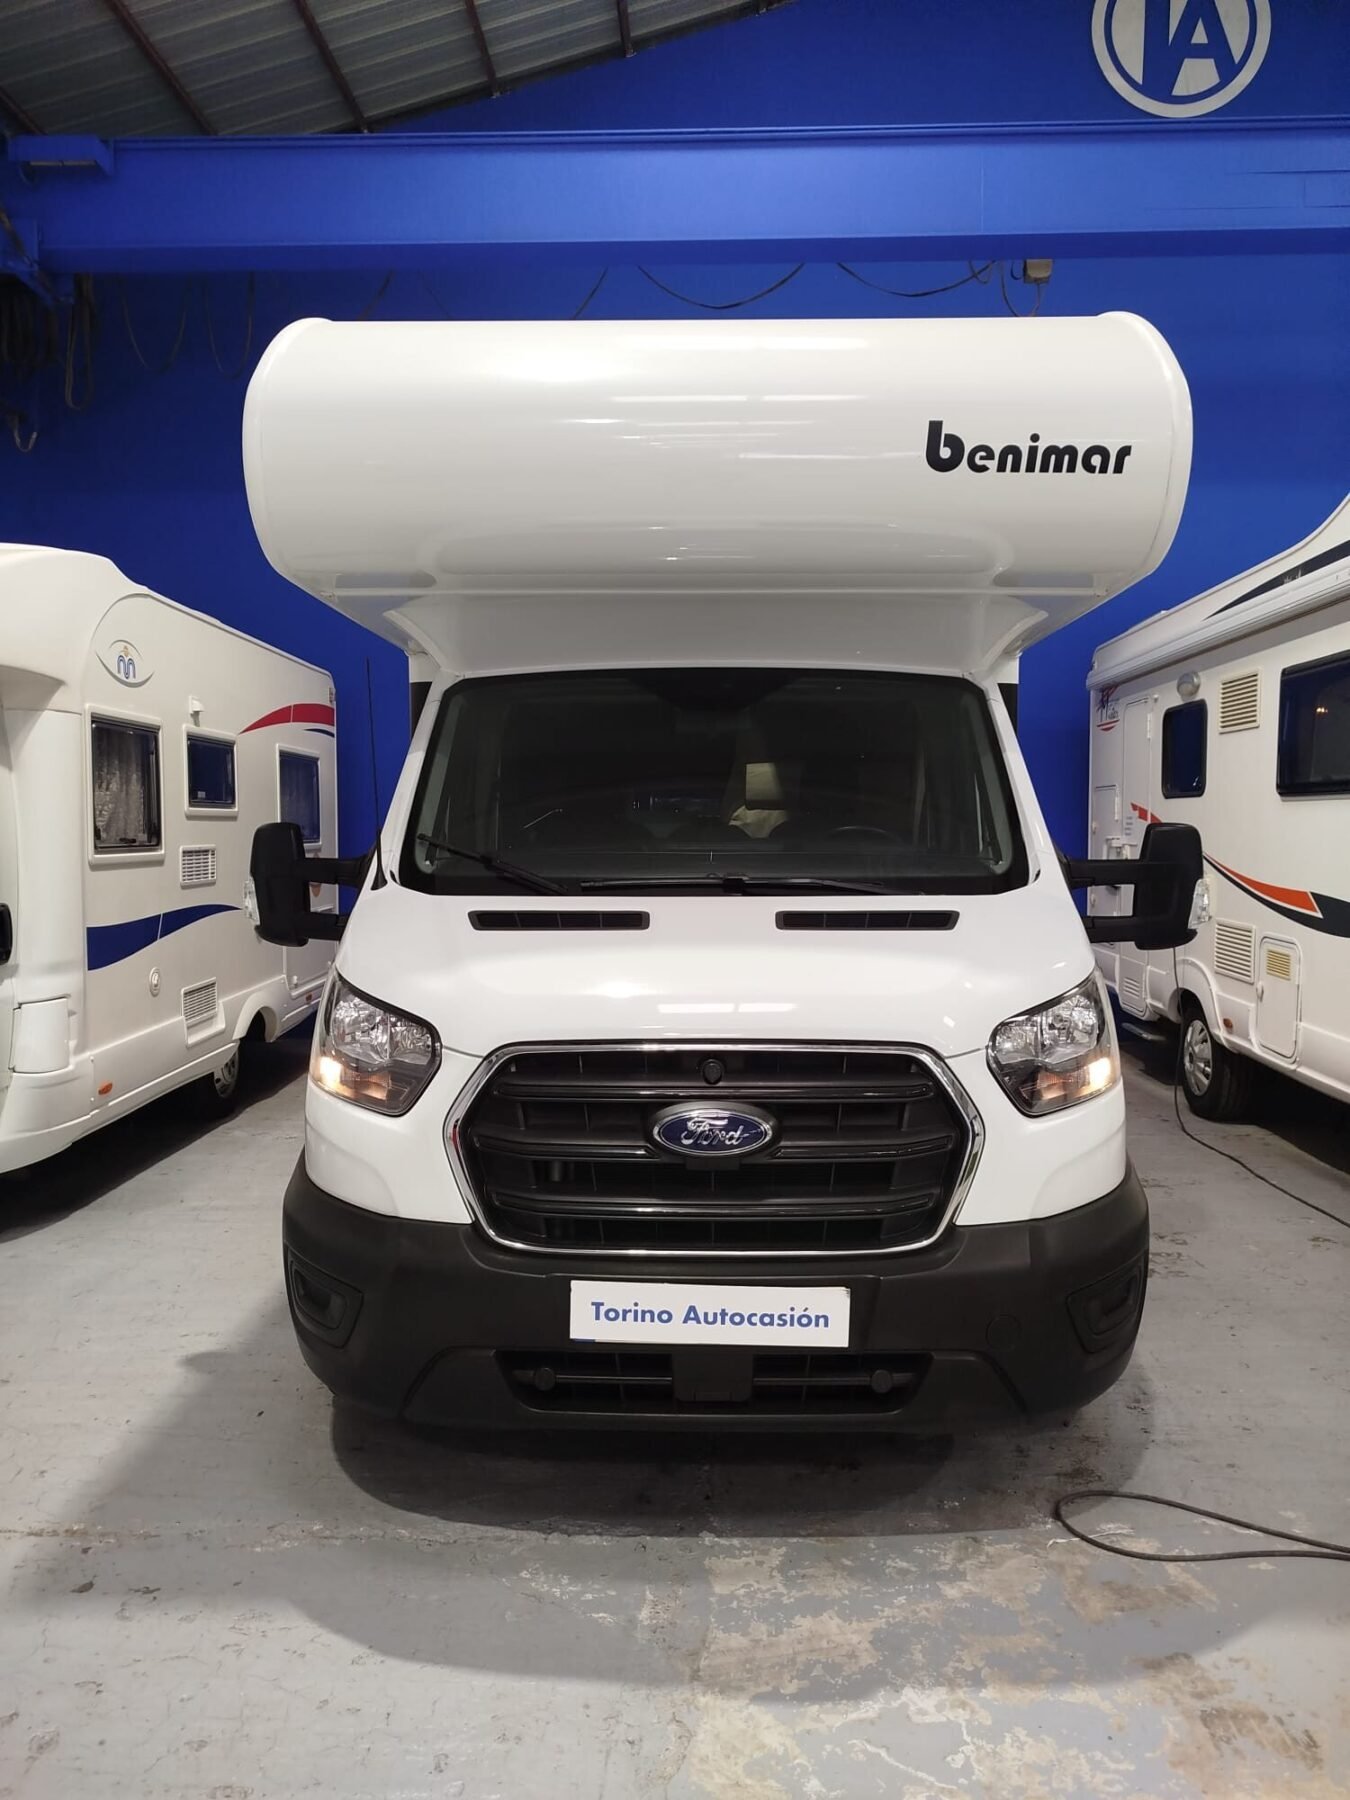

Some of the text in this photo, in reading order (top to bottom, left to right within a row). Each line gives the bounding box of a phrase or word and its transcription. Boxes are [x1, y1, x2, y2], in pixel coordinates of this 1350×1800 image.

[925, 420, 1132, 474] benimar
[681, 1117, 750, 1145] Ford
[591, 1301, 829, 1328] Torino Autocasión
